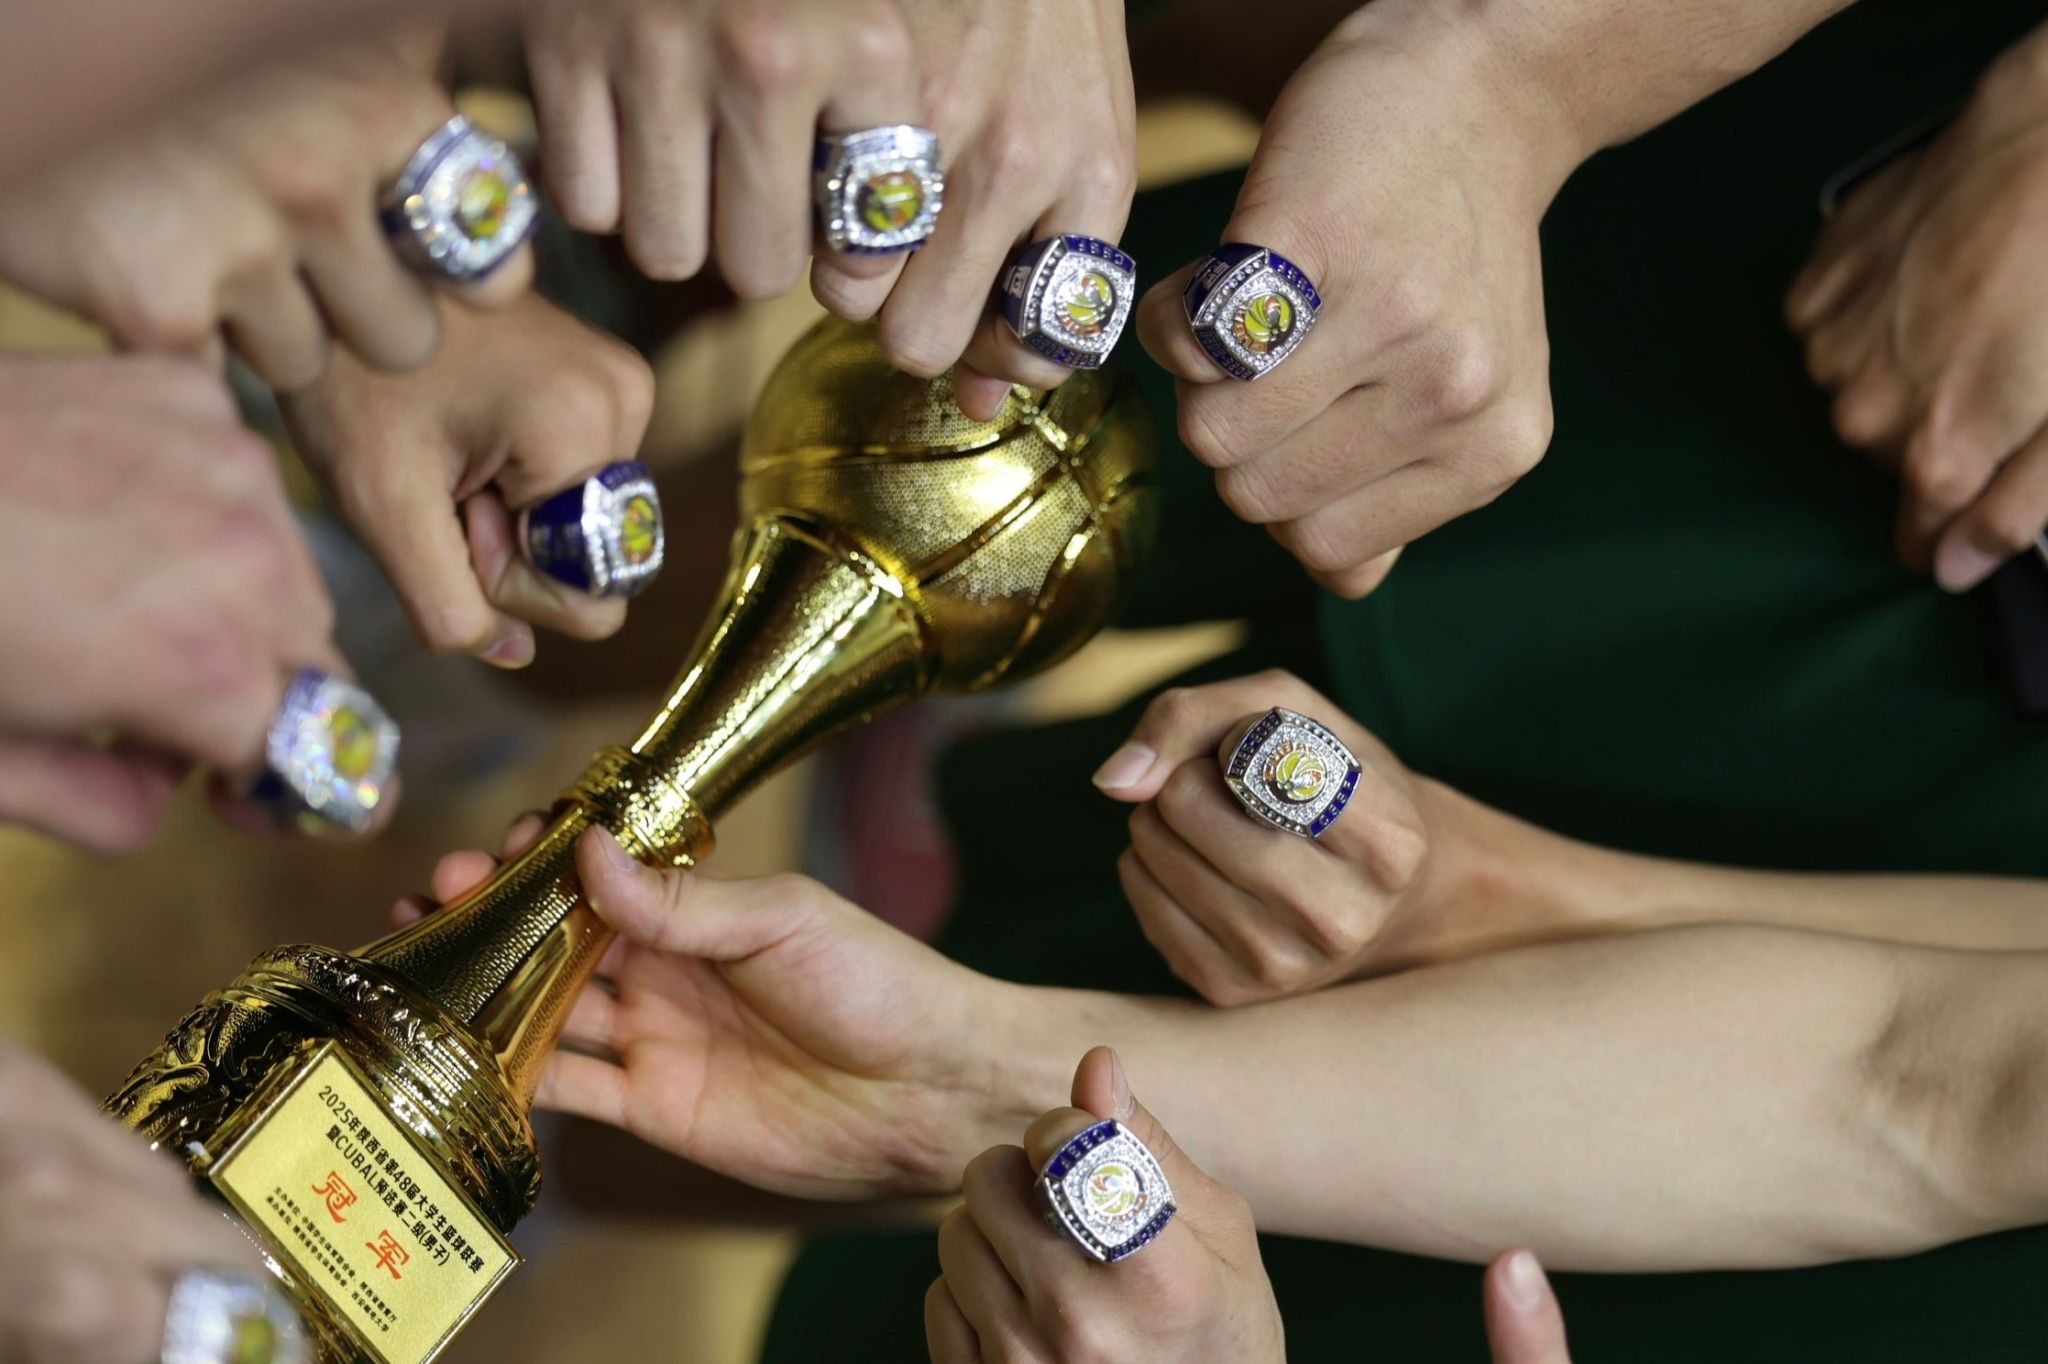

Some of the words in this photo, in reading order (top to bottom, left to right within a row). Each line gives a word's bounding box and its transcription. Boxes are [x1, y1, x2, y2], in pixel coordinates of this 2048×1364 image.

[311, 1170, 410, 1280] 冠军
[318, 1085, 485, 1274] 2025年陕西省第48届大学生篮球联赛
